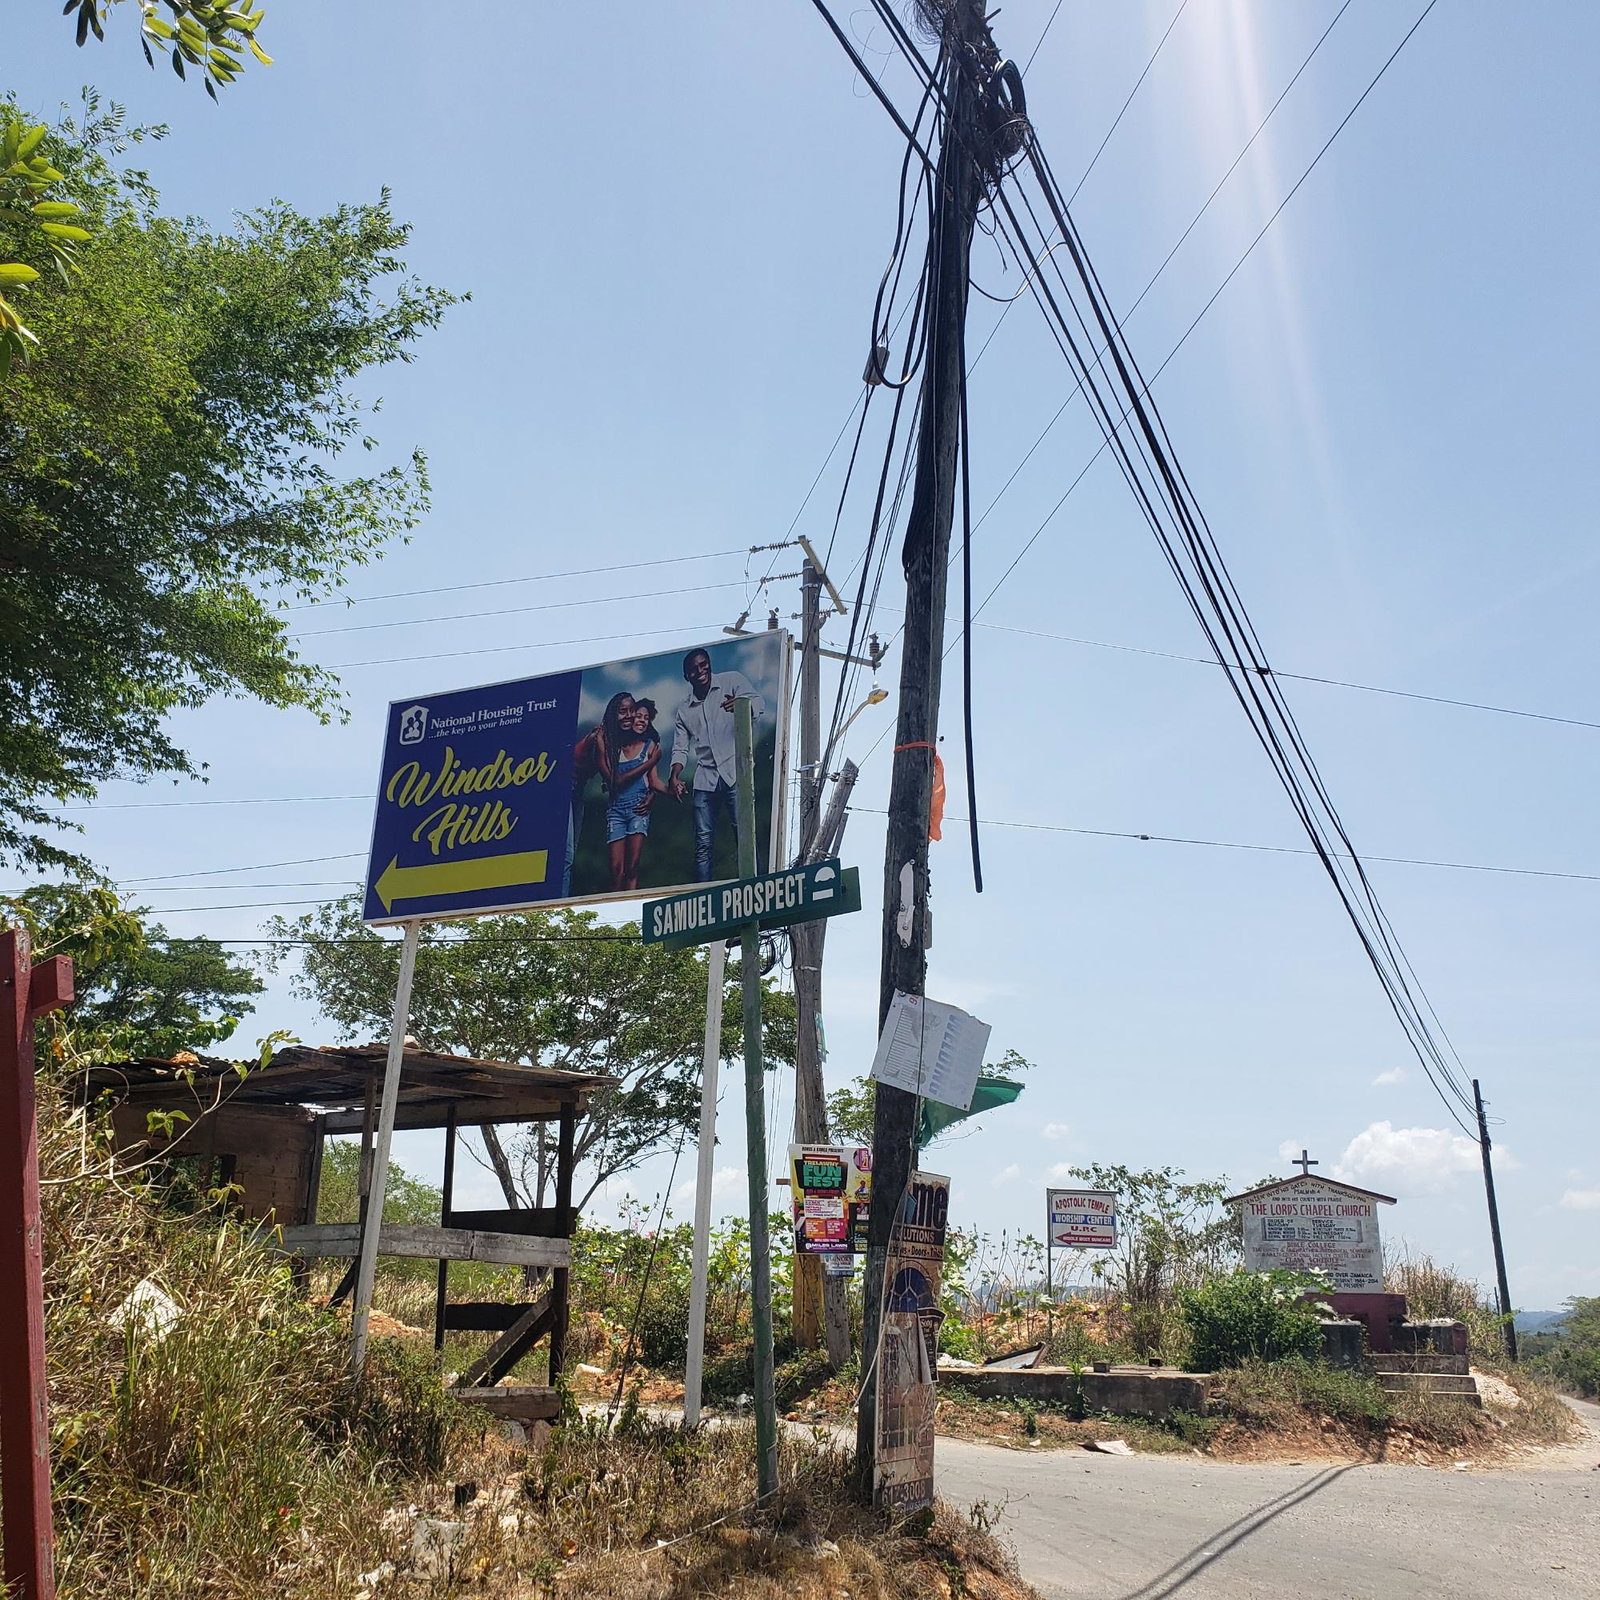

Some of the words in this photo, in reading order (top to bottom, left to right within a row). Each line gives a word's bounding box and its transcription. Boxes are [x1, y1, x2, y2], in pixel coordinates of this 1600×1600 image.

[430, 712, 476, 730] National
[477, 705, 524, 721] Housing
[526, 698, 558, 713] Trust
[451, 727, 466, 736] key
[478, 721, 497, 733] your
[499, 716, 523, 727] home
[386, 746, 557, 808] Windsor
[412, 800, 519, 856] Hills
[653, 894, 716, 937] SAMUEL
[722, 873, 806, 922] PROSPECT
[803, 1165, 842, 1177] FUN
[804, 1176, 842, 1188] FEST
[1055, 1197, 1086, 1211] APOSTOLIC
[1087, 1198, 1110, 1214] TEMPLE
[1250, 1204, 1267, 1215] THE
[1300, 1204, 1334, 1216] CHAPEL
[1336, 1205, 1371, 1217] CHURCH
[1055, 1214, 1085, 1223] WORSHIP
[1087, 1215, 1112, 1225] CENTER
[896, 1227, 935, 1243] SLUTIONS
[912, 1246, 926, 1257] Doors
